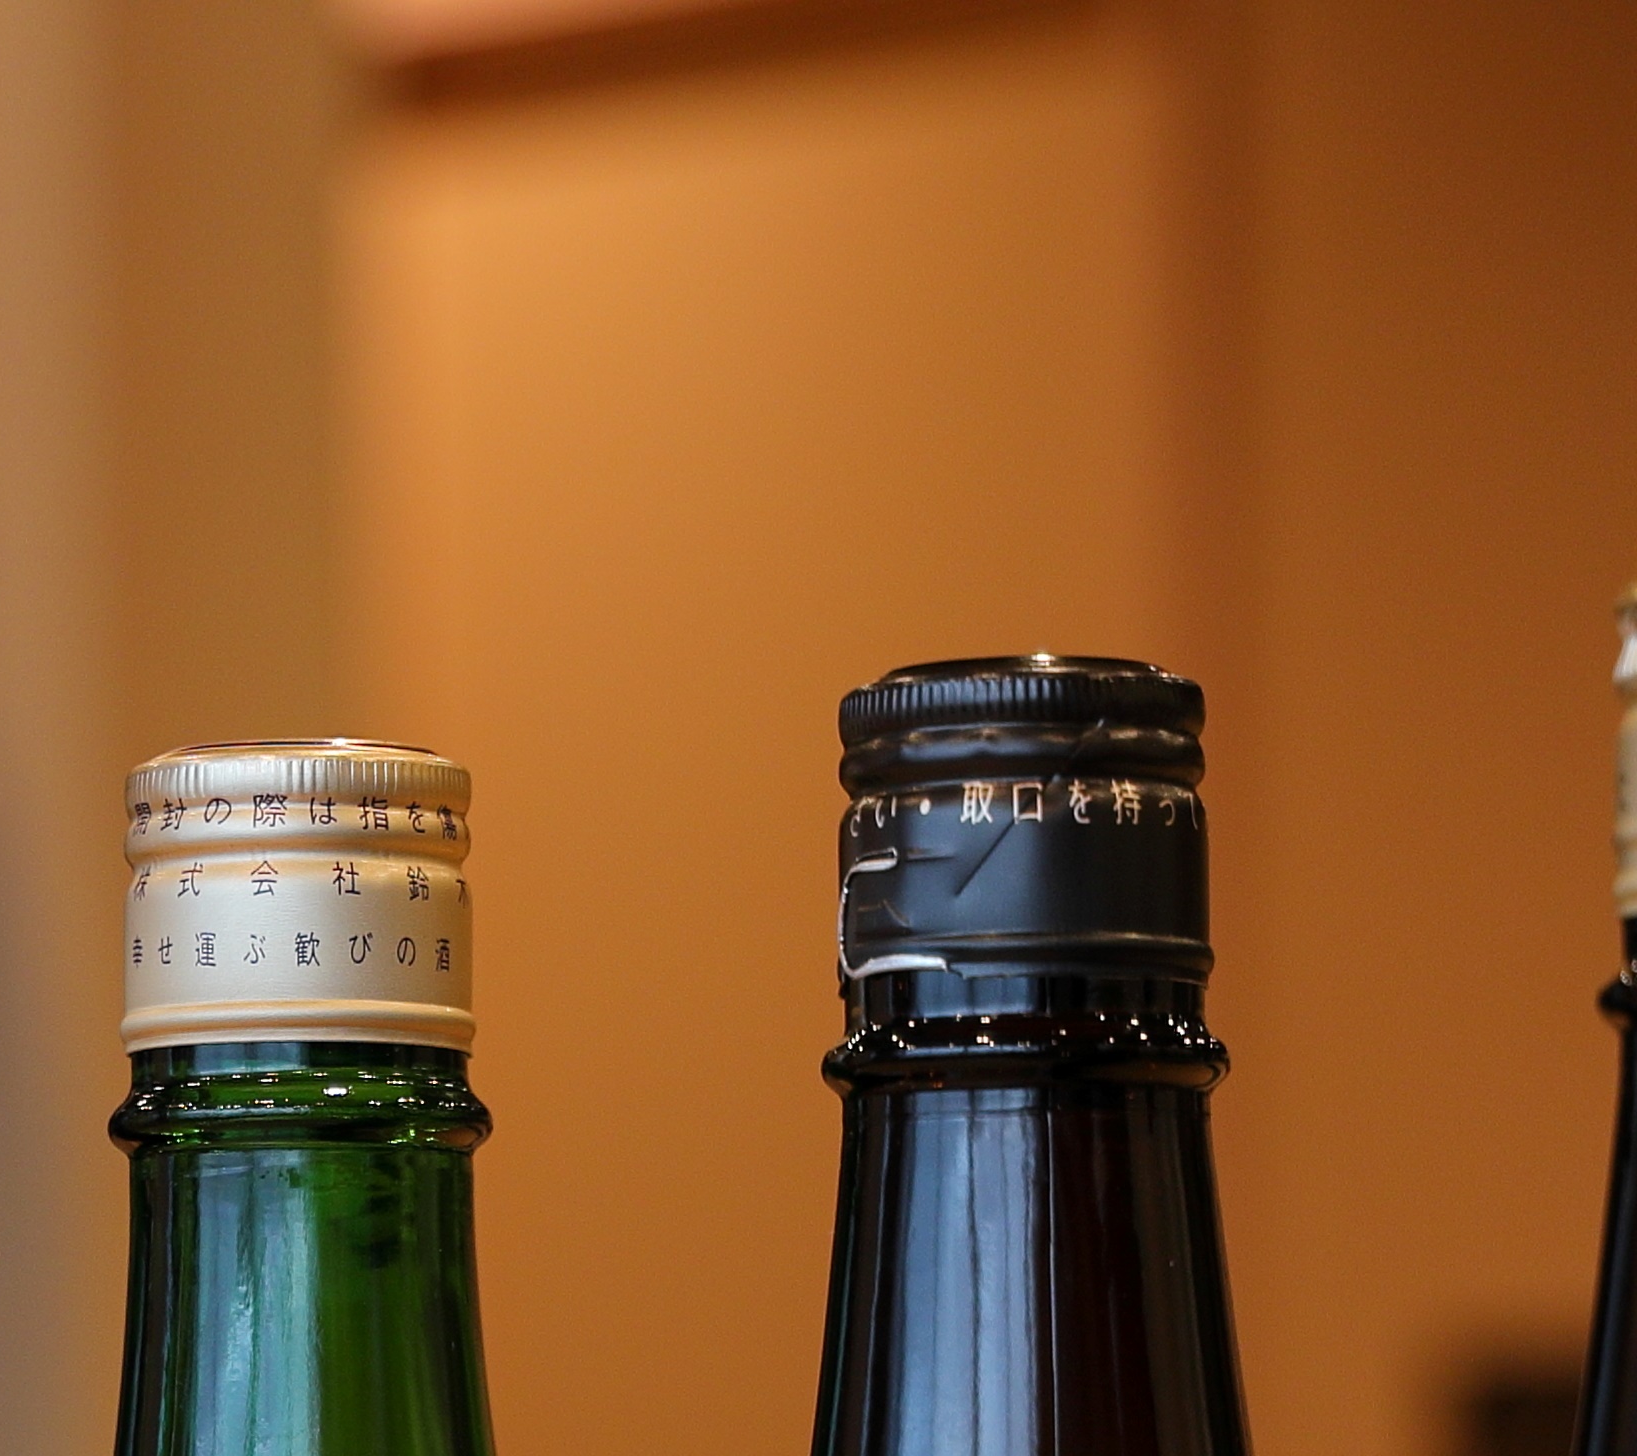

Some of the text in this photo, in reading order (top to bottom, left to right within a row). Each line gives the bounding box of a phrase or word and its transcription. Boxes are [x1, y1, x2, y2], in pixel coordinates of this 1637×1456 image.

[132, 932, 451, 972] 幸せ運ぶ歓びの酒
